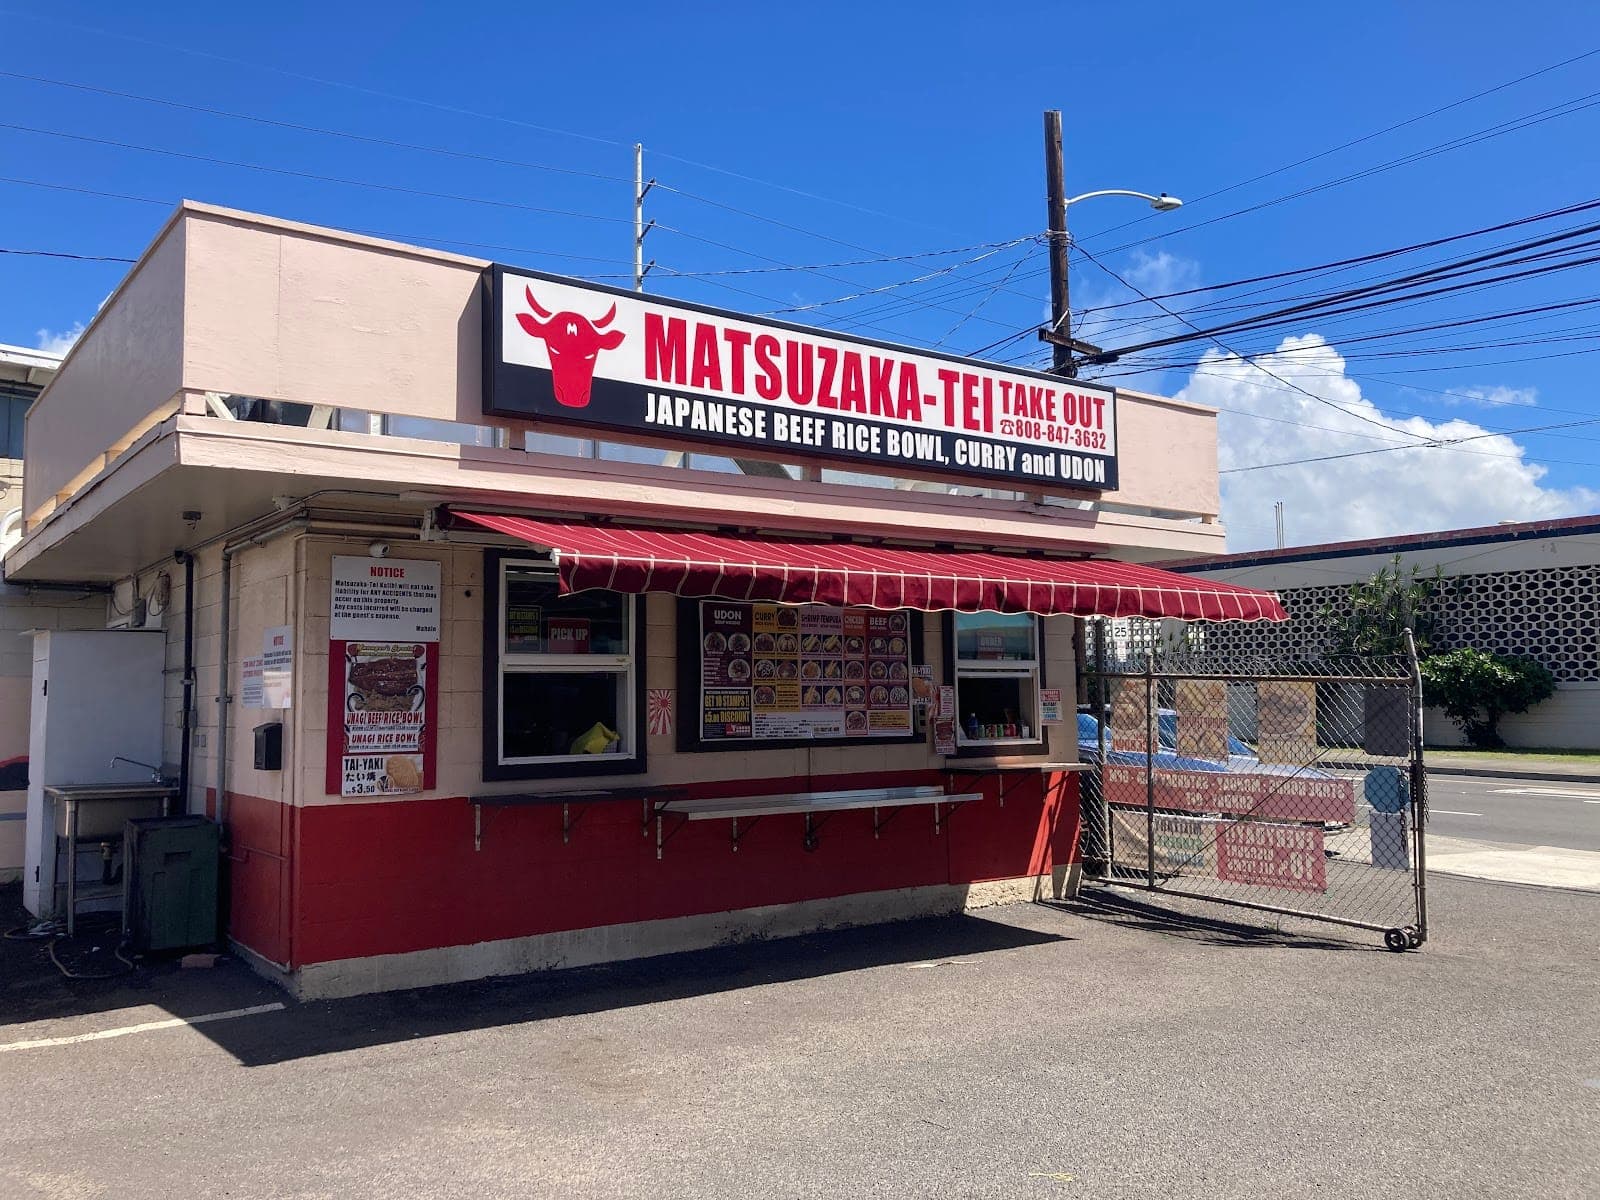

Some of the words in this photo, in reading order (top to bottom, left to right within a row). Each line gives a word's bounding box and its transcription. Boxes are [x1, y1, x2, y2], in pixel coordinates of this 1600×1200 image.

[566, 323, 577, 336] M
[643, 312, 995, 434] MATSUZAKA-TEI
[999, 379, 1057, 417] TAKE
[1062, 392, 1106, 430] OUT
[644, 392, 767, 440] JAPANESE
[773, 412, 825, 446] BEEF
[831, 419, 881, 454] RICE
[886, 427, 950, 468] BOWL,
[953, 437, 1017, 472] CURRY
[1020, 450, 1056, 478] and
[1059, 452, 1106, 485] UDON
[1015, 419, 1107, 451] 808-847-3632
[370, 566, 405, 578] NOTICE
[714, 610, 742, 620] UDON
[755, 612, 775, 620] CURRY
[801, 614, 820, 623] SHRIMP
[870, 617, 888, 625] BEEF
[551, 628, 573, 640] PICK
[576, 628, 588, 640] UP
[1114, 627, 1127, 637] 25
[705, 695, 716, 707] GET
[723, 694, 745, 707] STAMPS
[346, 712, 366, 724] UNAGI
[368, 712, 382, 724] BEEF
[384, 712, 400, 724] RICE
[402, 712, 422, 723] BOWL
[720, 711, 750, 722] DISCOUNT
[352, 734, 375, 743] UNAGI
[377, 733, 393, 743] RICE
[396, 733, 416, 742] BOWL
[344, 758, 383, 770] TAI-YAKI
[352, 784, 375, 794] $3.50
